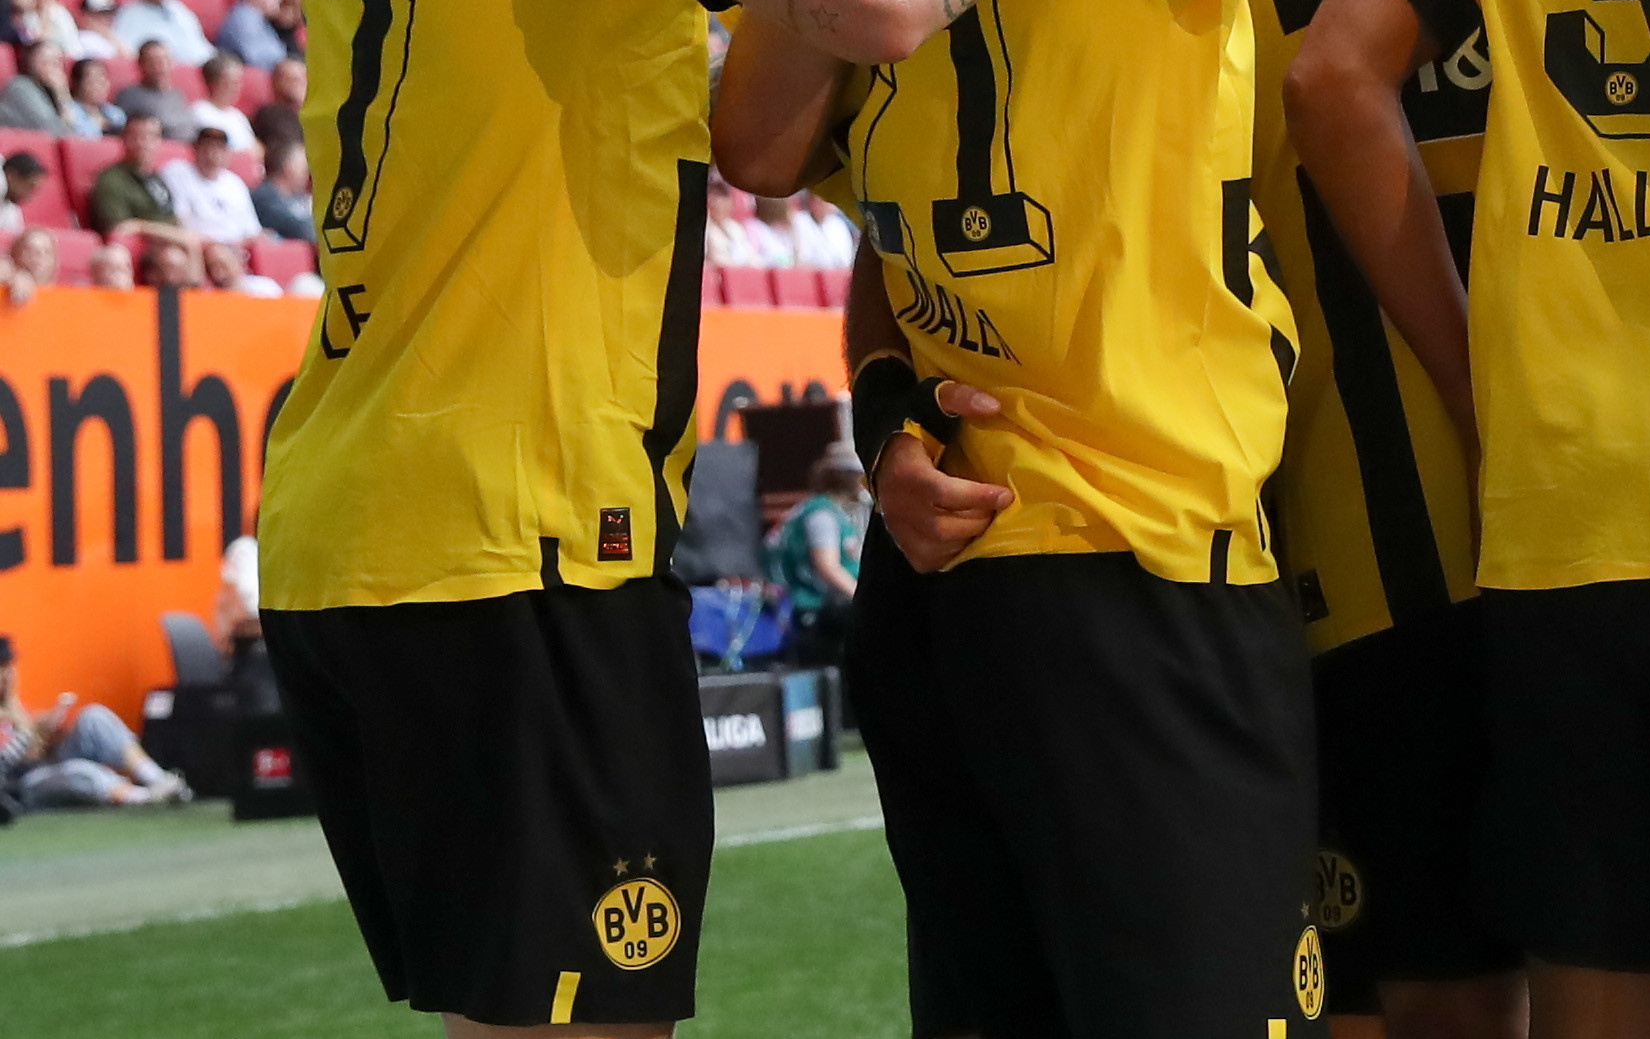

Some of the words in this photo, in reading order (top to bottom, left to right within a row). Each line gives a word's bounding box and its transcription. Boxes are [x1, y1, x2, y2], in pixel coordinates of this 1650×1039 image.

[1610, 75, 1634, 95] BVB
[965, 210, 988, 232] BVB
[604, 886, 670, 944] BVB
[624, 940, 648, 960] 09
[1299, 935, 1320, 991] BVB
